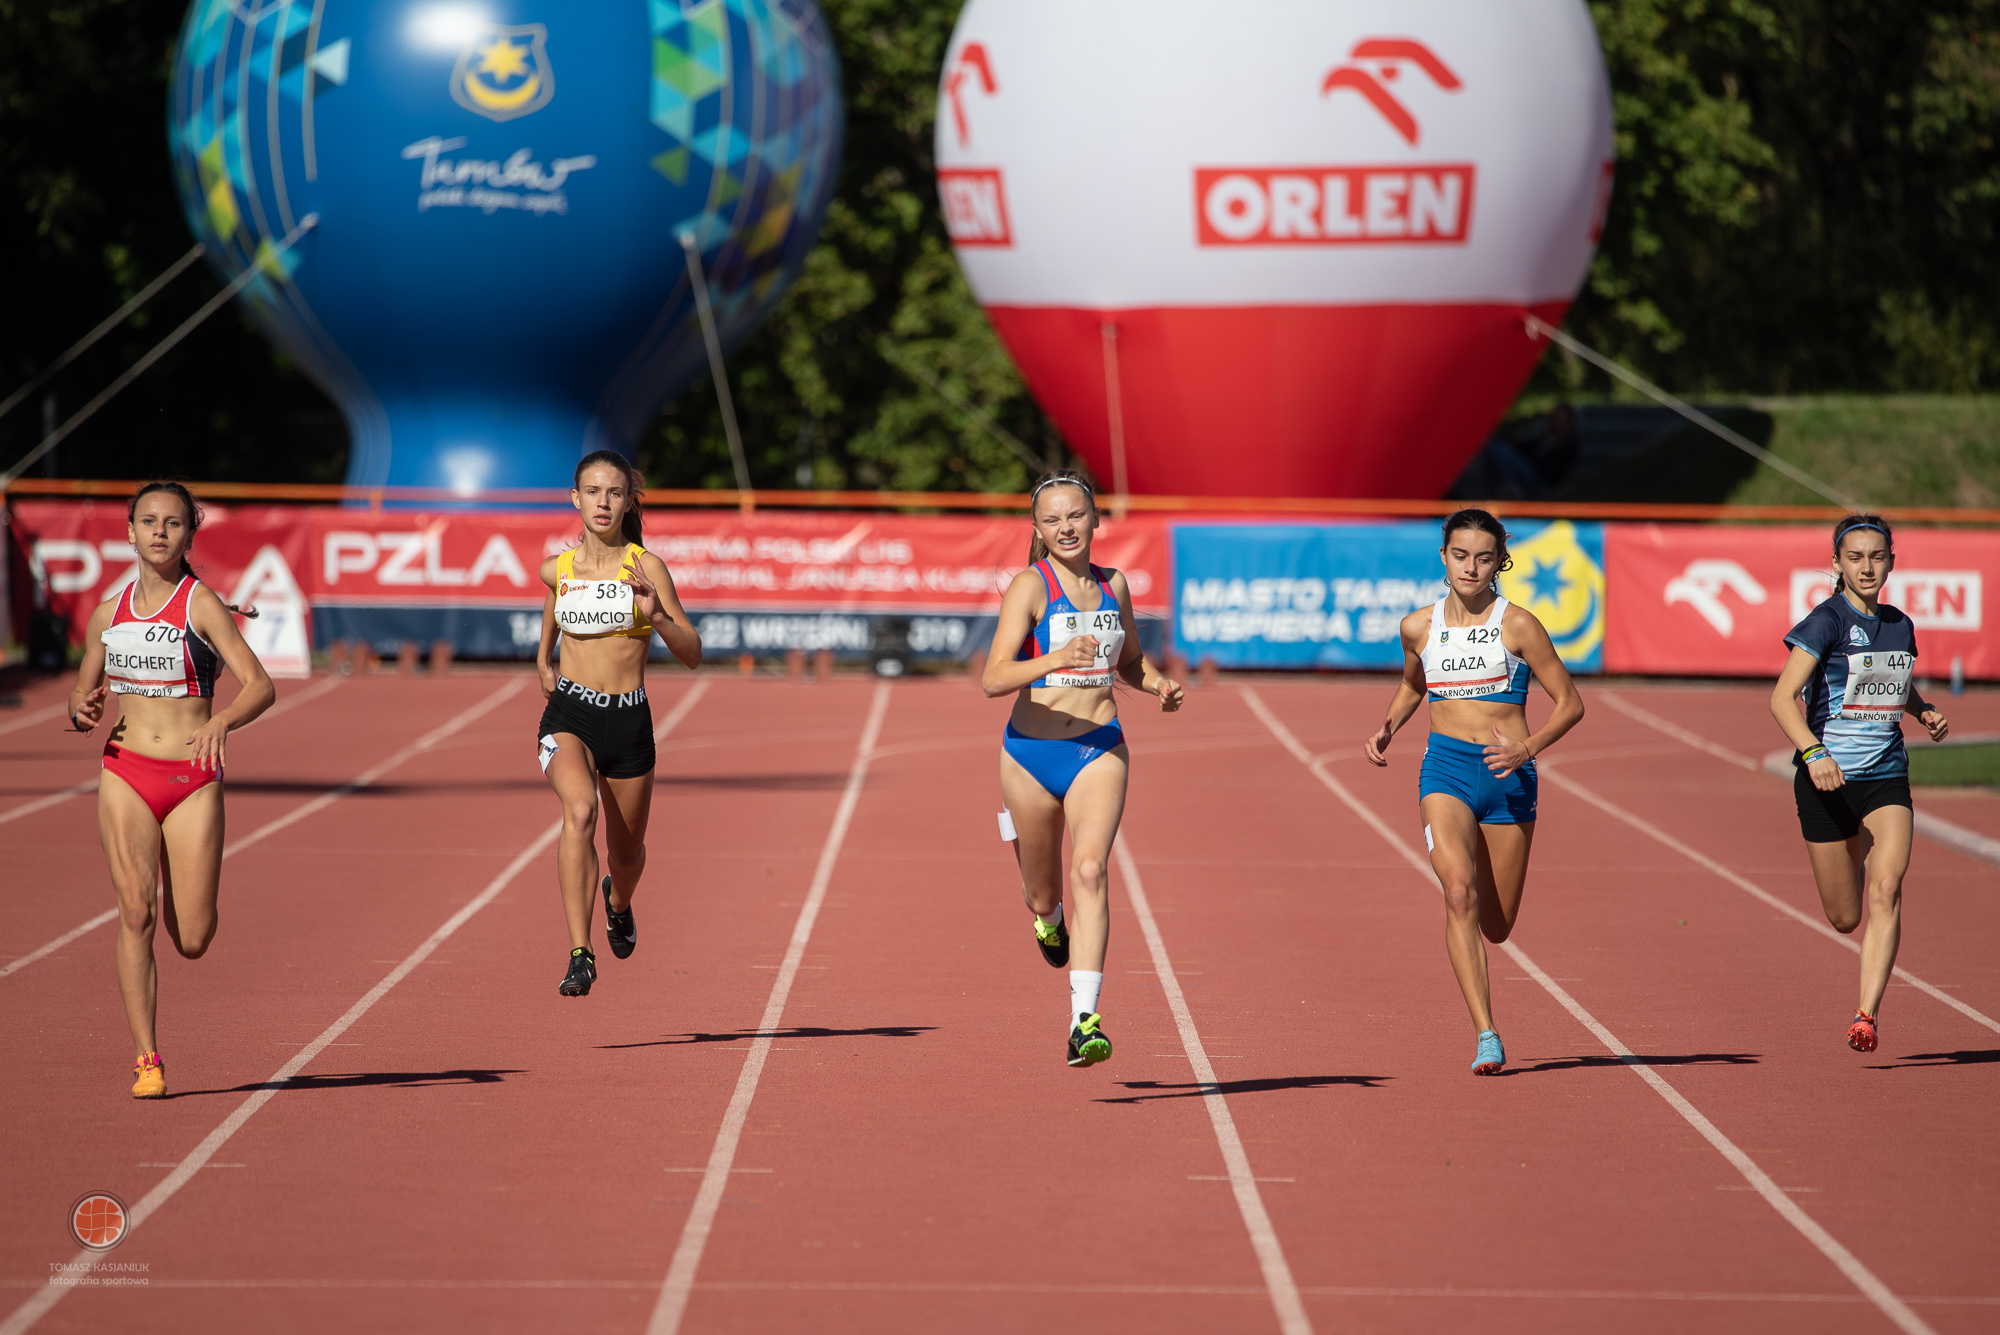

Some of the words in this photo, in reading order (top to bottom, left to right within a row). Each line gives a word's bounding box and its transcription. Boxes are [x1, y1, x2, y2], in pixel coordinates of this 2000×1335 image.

[1204, 171, 1464, 242] ORLEN
[323, 531, 529, 587] PZLA
[32, 540, 309, 604] PZA
[1181, 577, 1326, 612] MIASTO
[1331, 578, 1449, 611] TARN
[1805, 578, 1968, 619] OEN
[561, 611, 625, 625] ADAMCIO
[1180, 610, 1351, 643] WSPIERA
[145, 625, 181, 643] 670
[1467, 627, 1500, 644] 429
[108, 652, 176, 671] REJCHERT
[1441, 656, 1487, 672] GLAZA
[1887, 654, 1913, 670] 447
[120, 683, 149, 697] TARNÓW
[151, 688, 173, 697] 2019
[1060, 677, 1098, 688] TARNÓW
[1438, 686, 1474, 698] TARNÓW
[1475, 684, 1496, 695] 2019
[567, 682, 611, 708] PRO
[1853, 711, 1888, 721] TARNÓW
